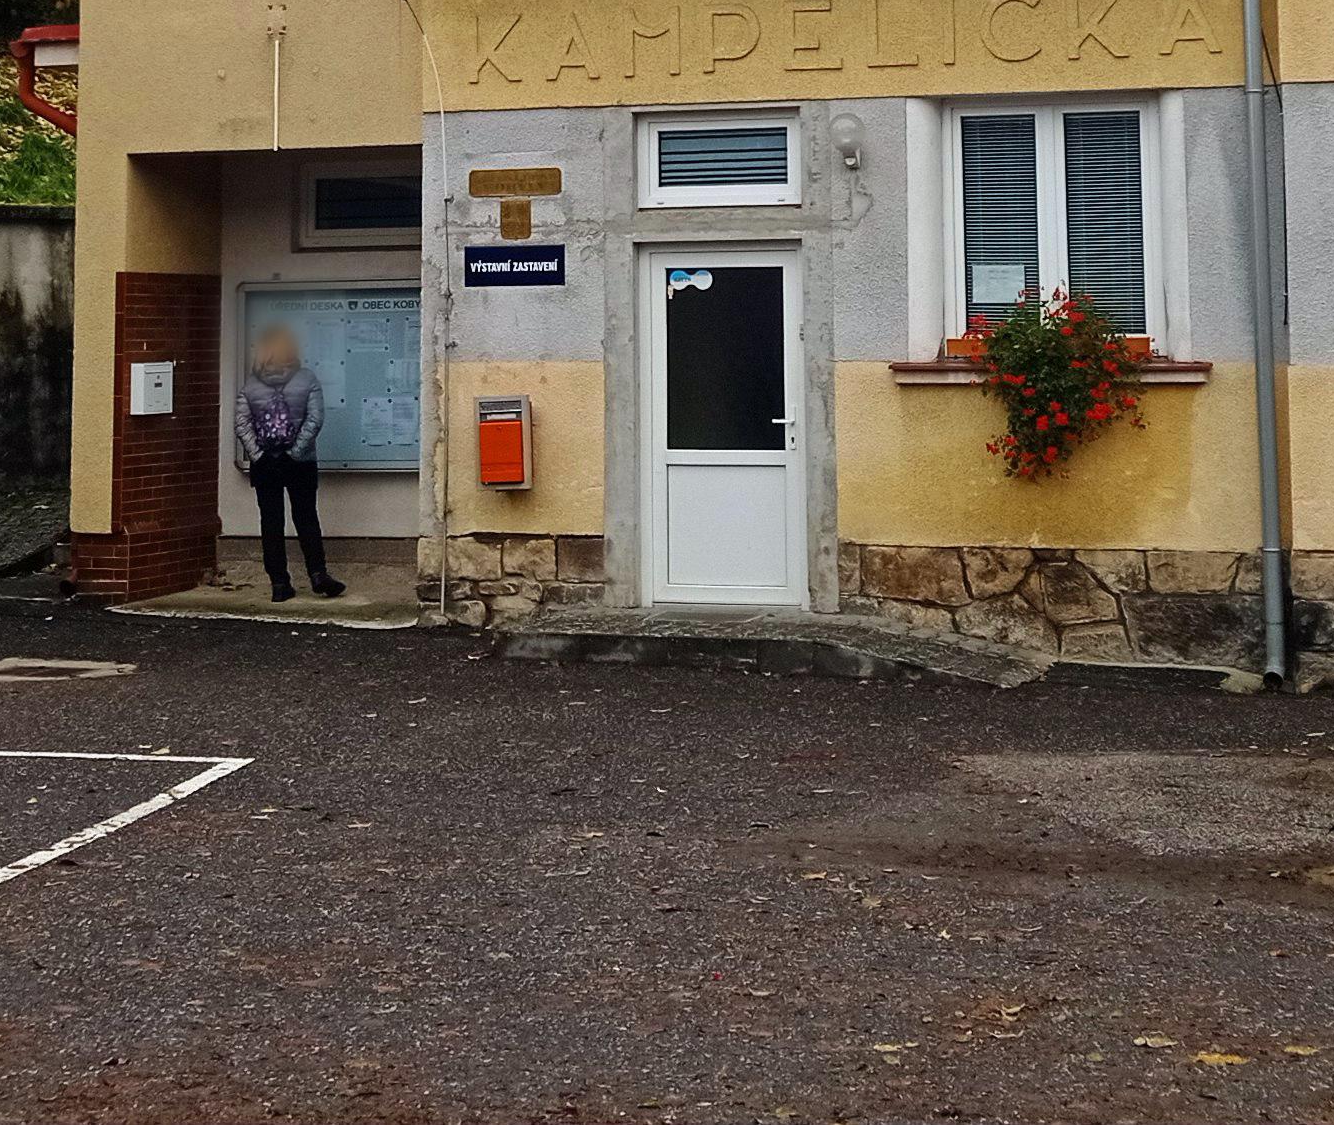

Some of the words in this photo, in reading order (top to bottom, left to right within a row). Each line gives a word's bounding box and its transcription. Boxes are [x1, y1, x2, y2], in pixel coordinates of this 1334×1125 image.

[470, 259, 511, 273] VÝSTAVNÍ
[512, 258, 558, 272] ZASTAVENÍ
[311, 301, 343, 311] DESKA
[362, 300, 391, 309] OBEC
